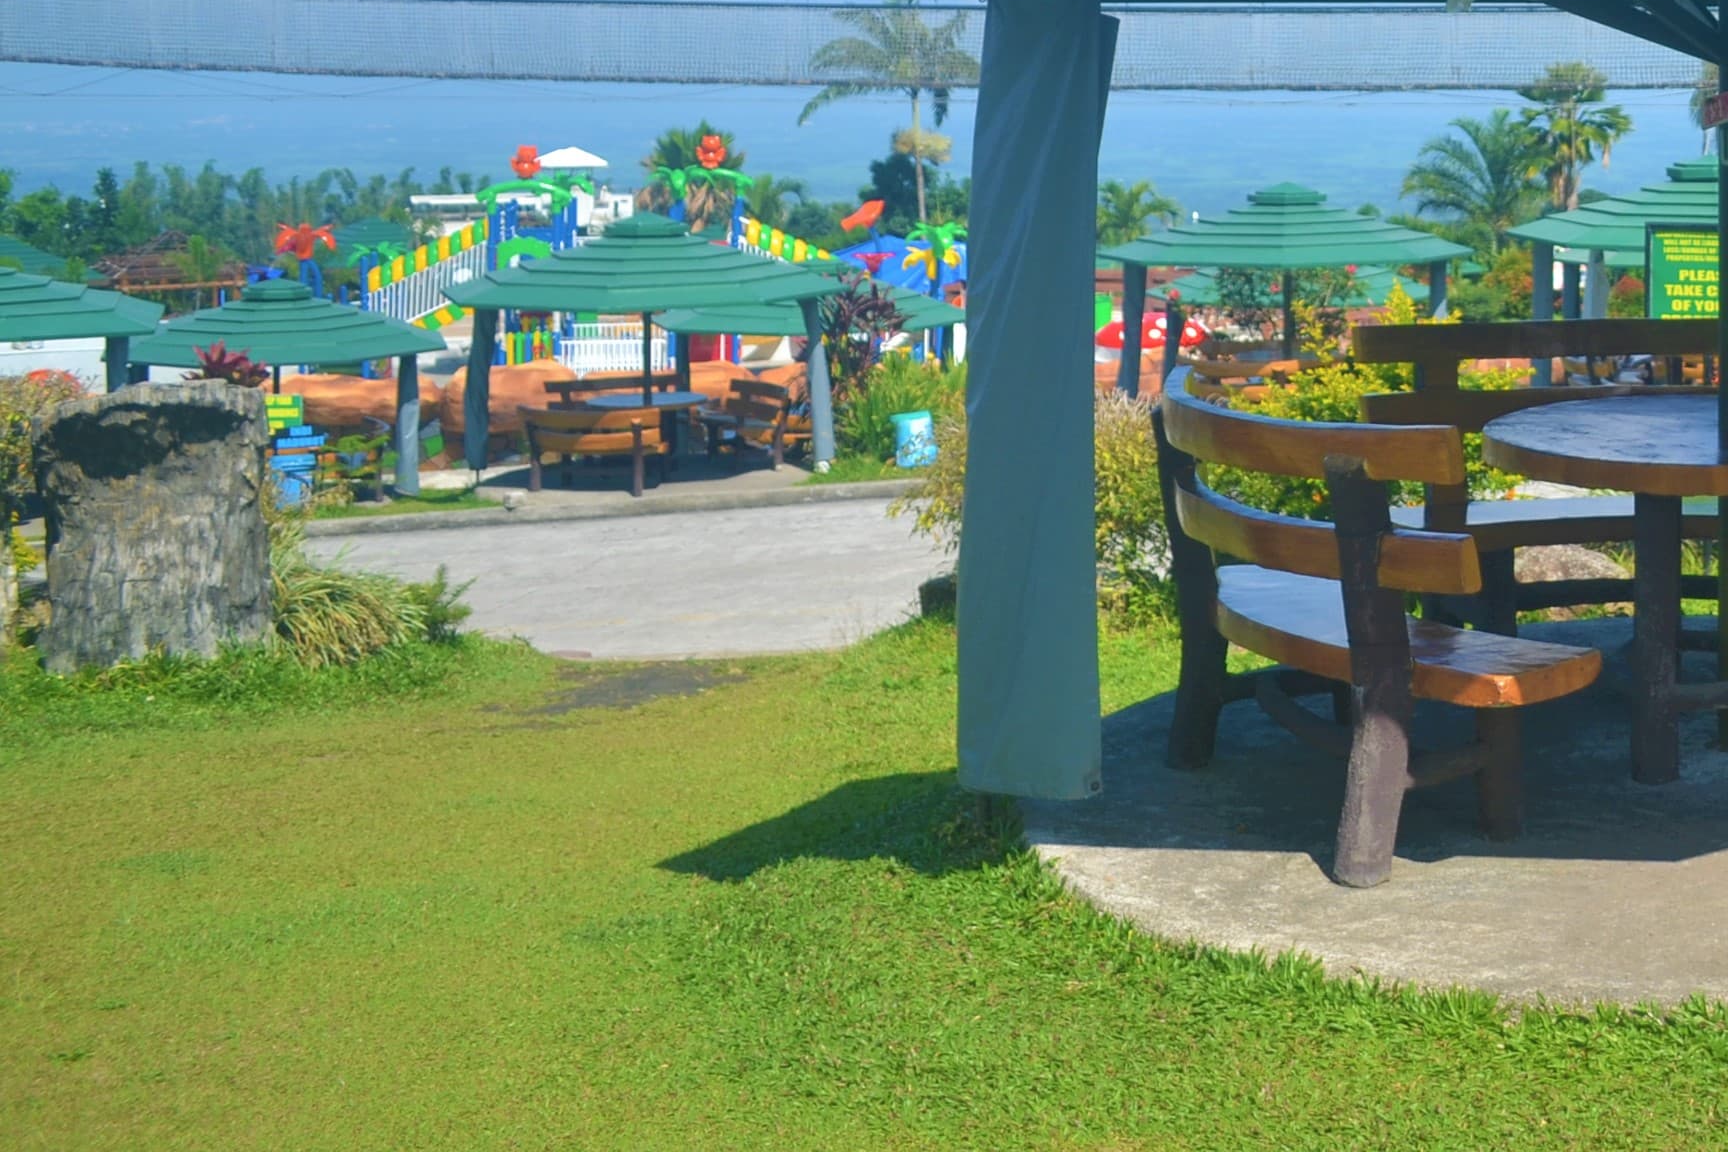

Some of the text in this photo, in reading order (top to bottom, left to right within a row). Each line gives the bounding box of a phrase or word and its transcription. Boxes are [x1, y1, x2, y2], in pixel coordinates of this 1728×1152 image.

[1679, 269, 1719, 281] PLEA
[1664, 284, 1704, 297] TAKE
[1671, 299, 1692, 311] OF
